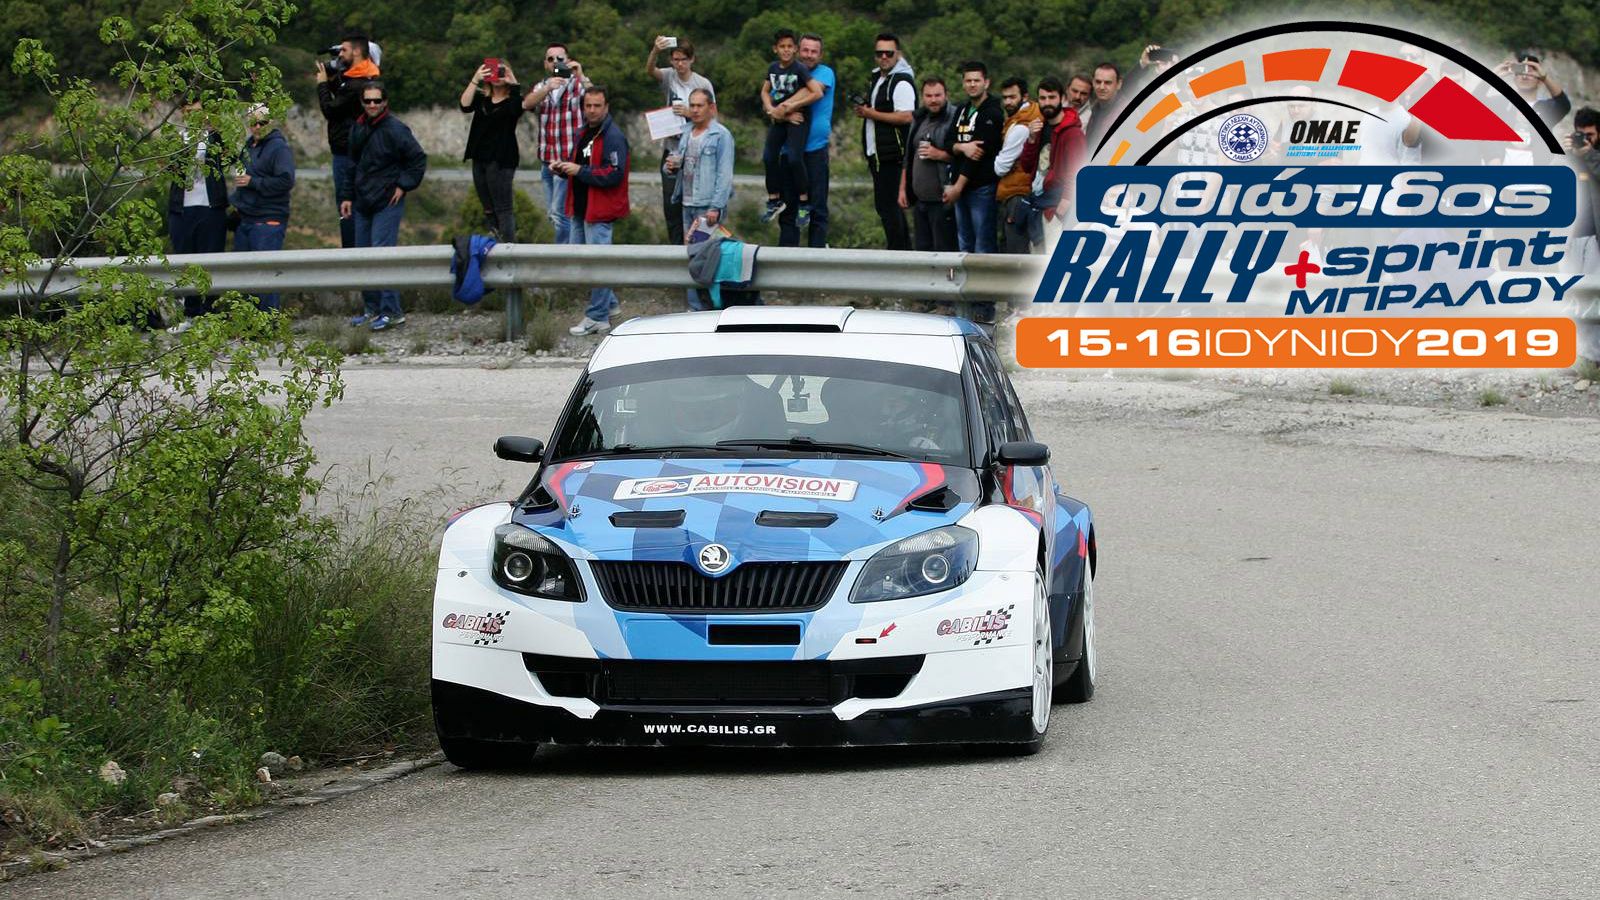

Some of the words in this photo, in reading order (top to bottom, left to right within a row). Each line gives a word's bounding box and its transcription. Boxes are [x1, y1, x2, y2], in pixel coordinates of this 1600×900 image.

[696, 476, 840, 493] AUTOVISION
[443, 613, 502, 634] CABILIS
[937, 614, 1006, 636] CABILIS
[643, 724, 777, 735] WWW.CABILIS.GR
